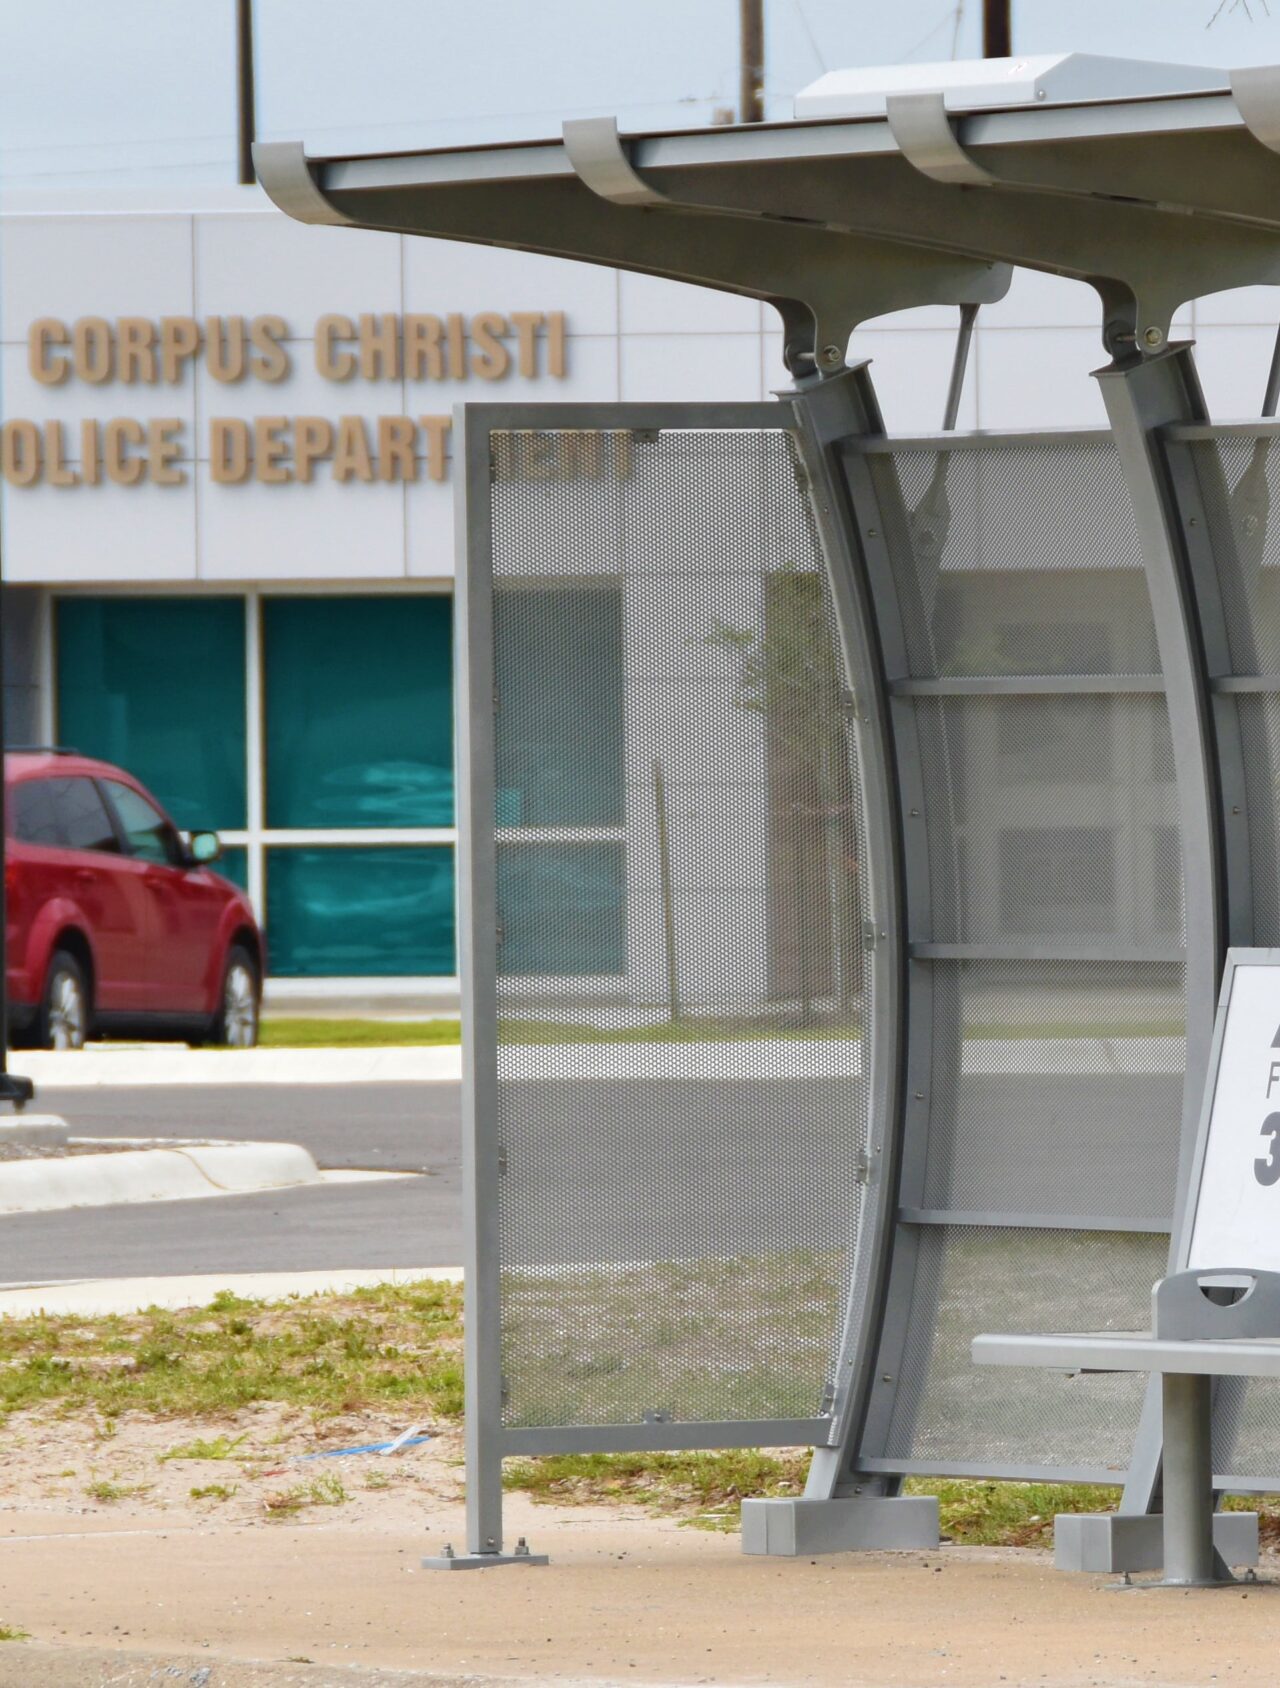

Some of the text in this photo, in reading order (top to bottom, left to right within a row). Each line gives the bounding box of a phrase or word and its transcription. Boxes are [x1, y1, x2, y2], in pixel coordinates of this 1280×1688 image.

[28, 312, 566, 385] CORPUS CHRISTI
[0, 418, 184, 487] OLICE
